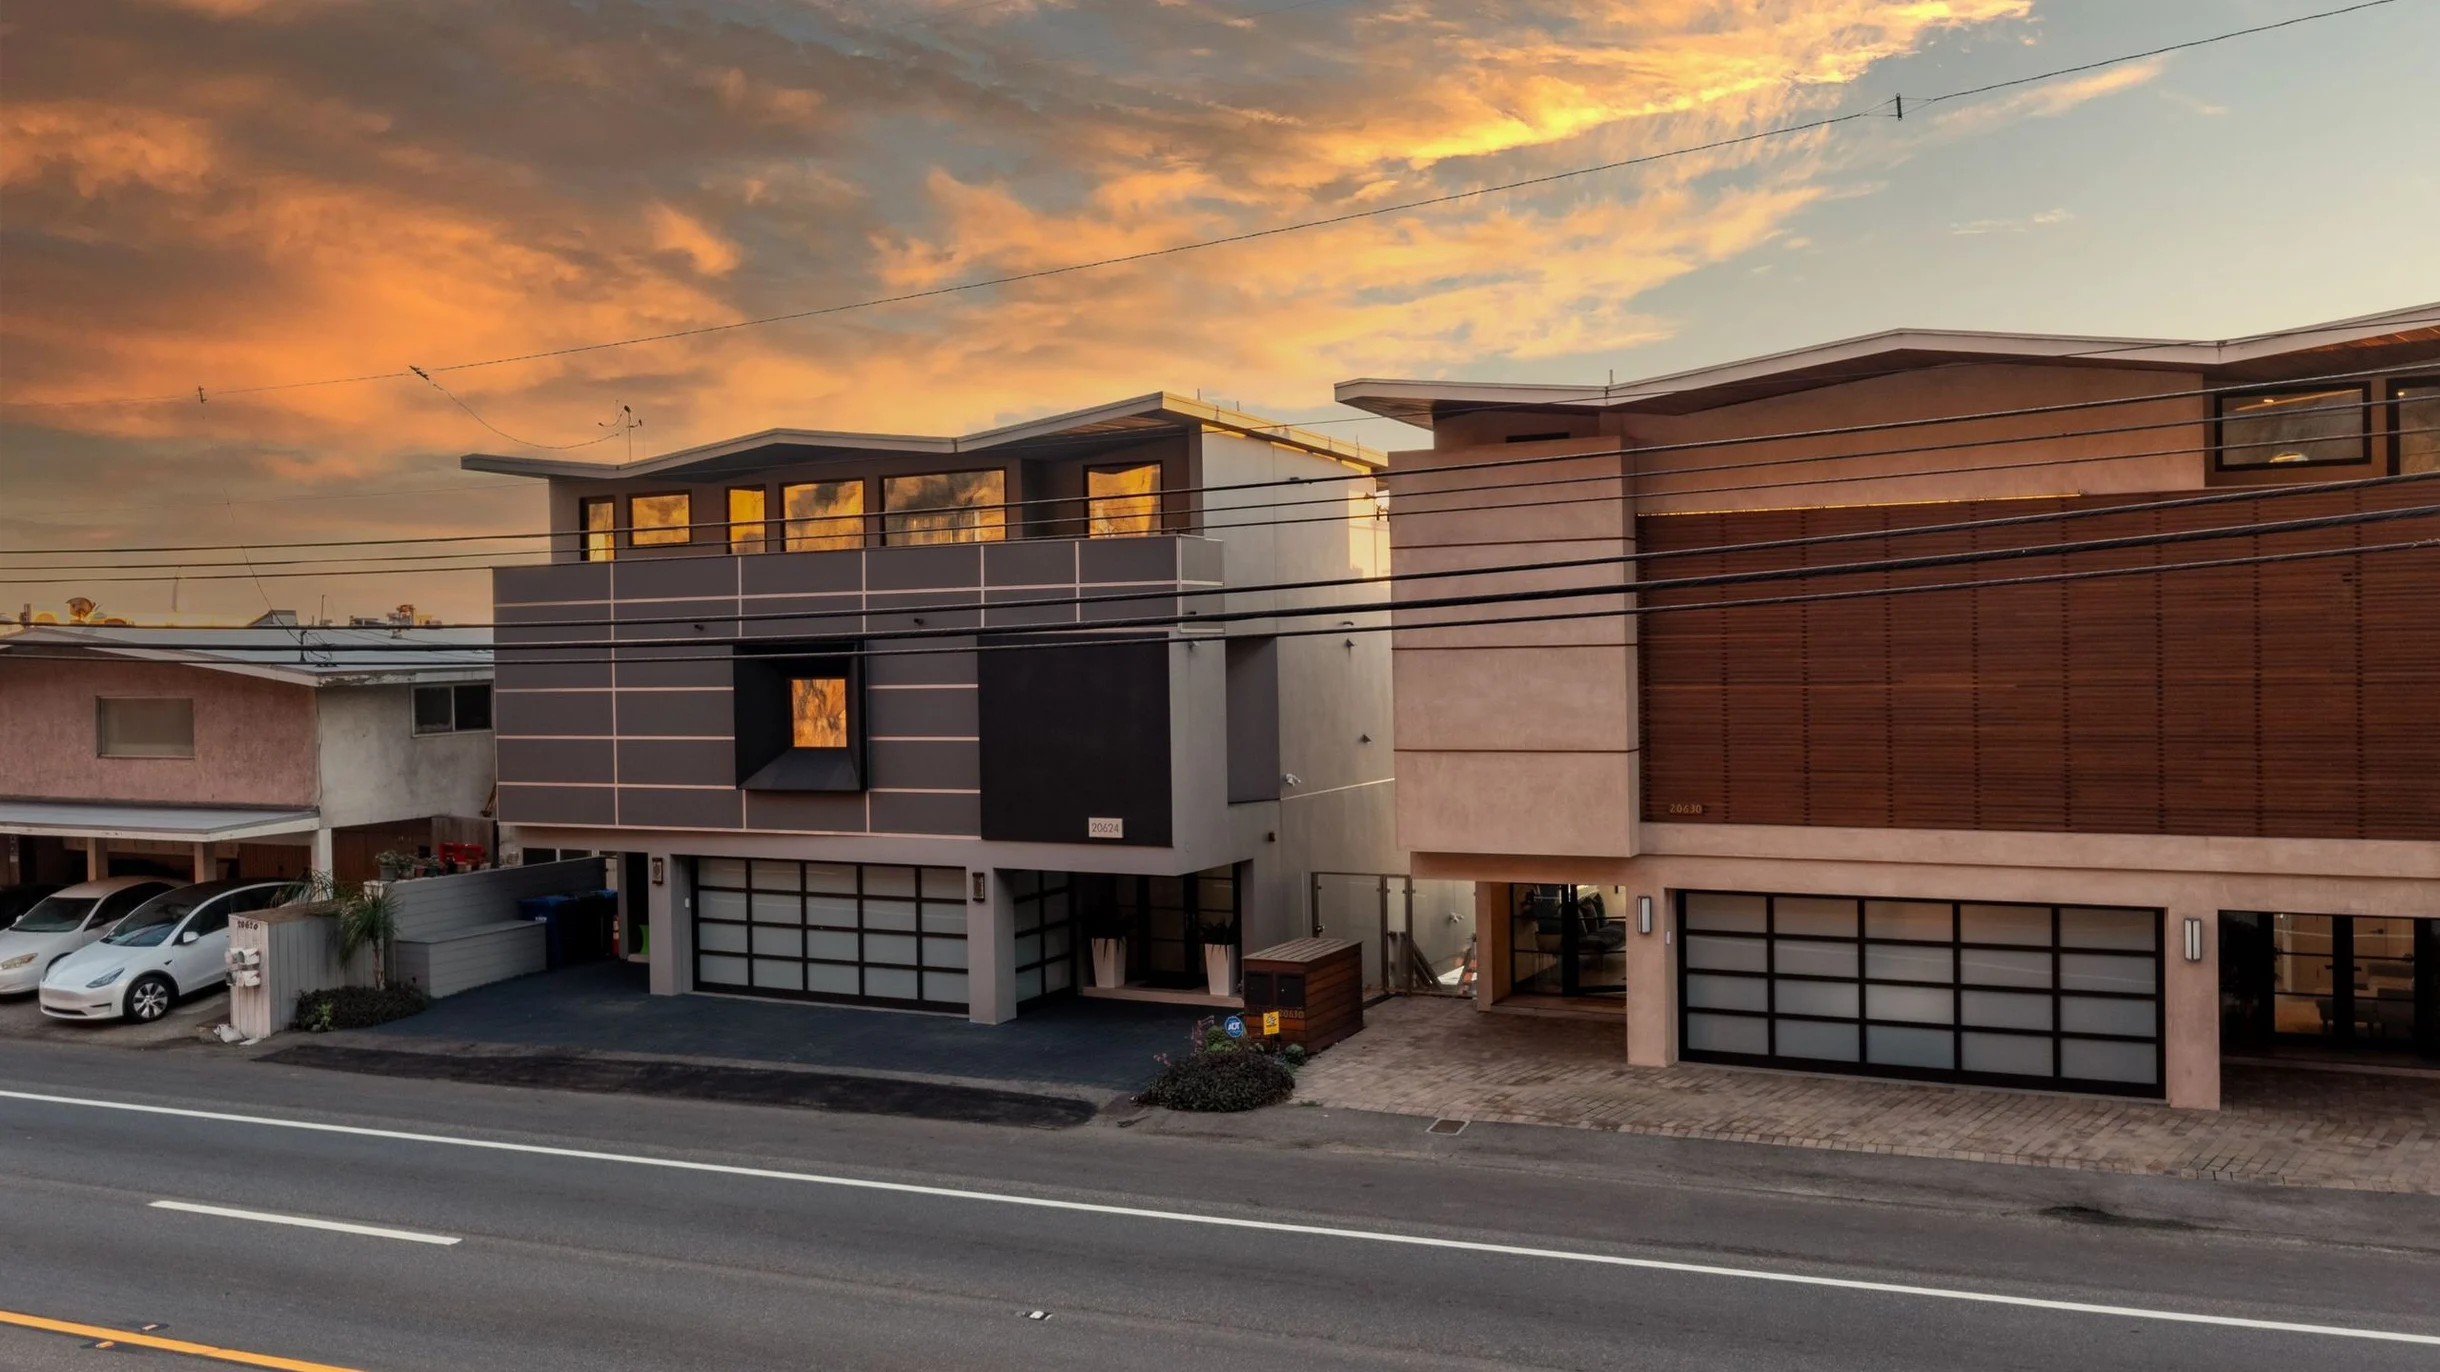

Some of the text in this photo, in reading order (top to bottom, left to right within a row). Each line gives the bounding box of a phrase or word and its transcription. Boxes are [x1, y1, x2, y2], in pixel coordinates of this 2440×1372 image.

[1669, 803, 1702, 814] 20630
[1091, 822, 1119, 833] 20624
[1227, 1022, 1241, 1031] ADT
